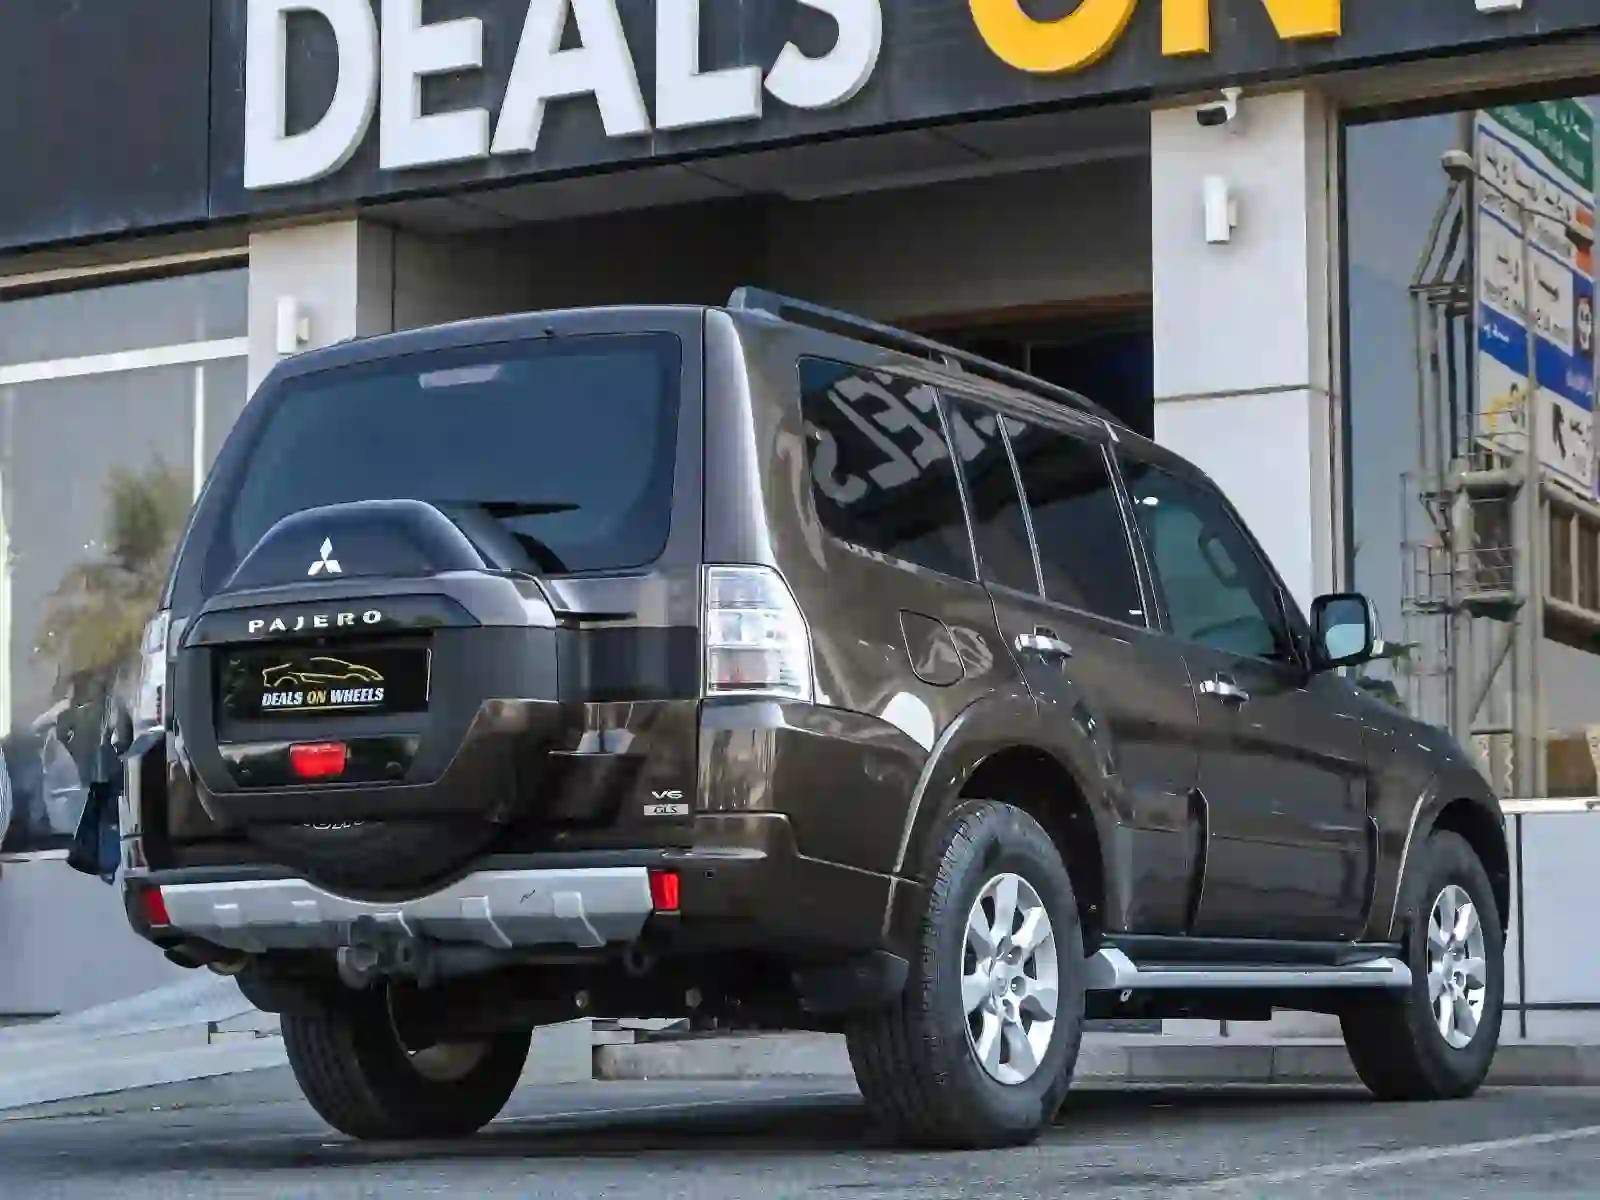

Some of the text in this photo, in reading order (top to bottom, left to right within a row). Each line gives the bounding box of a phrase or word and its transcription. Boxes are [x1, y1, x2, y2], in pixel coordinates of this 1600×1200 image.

[243, 0, 883, 190] DEALS
[248, 610, 382, 633] PAJERO
[262, 687, 385, 706] DEALS ON WHEELS
[651, 790, 683, 799] V6
